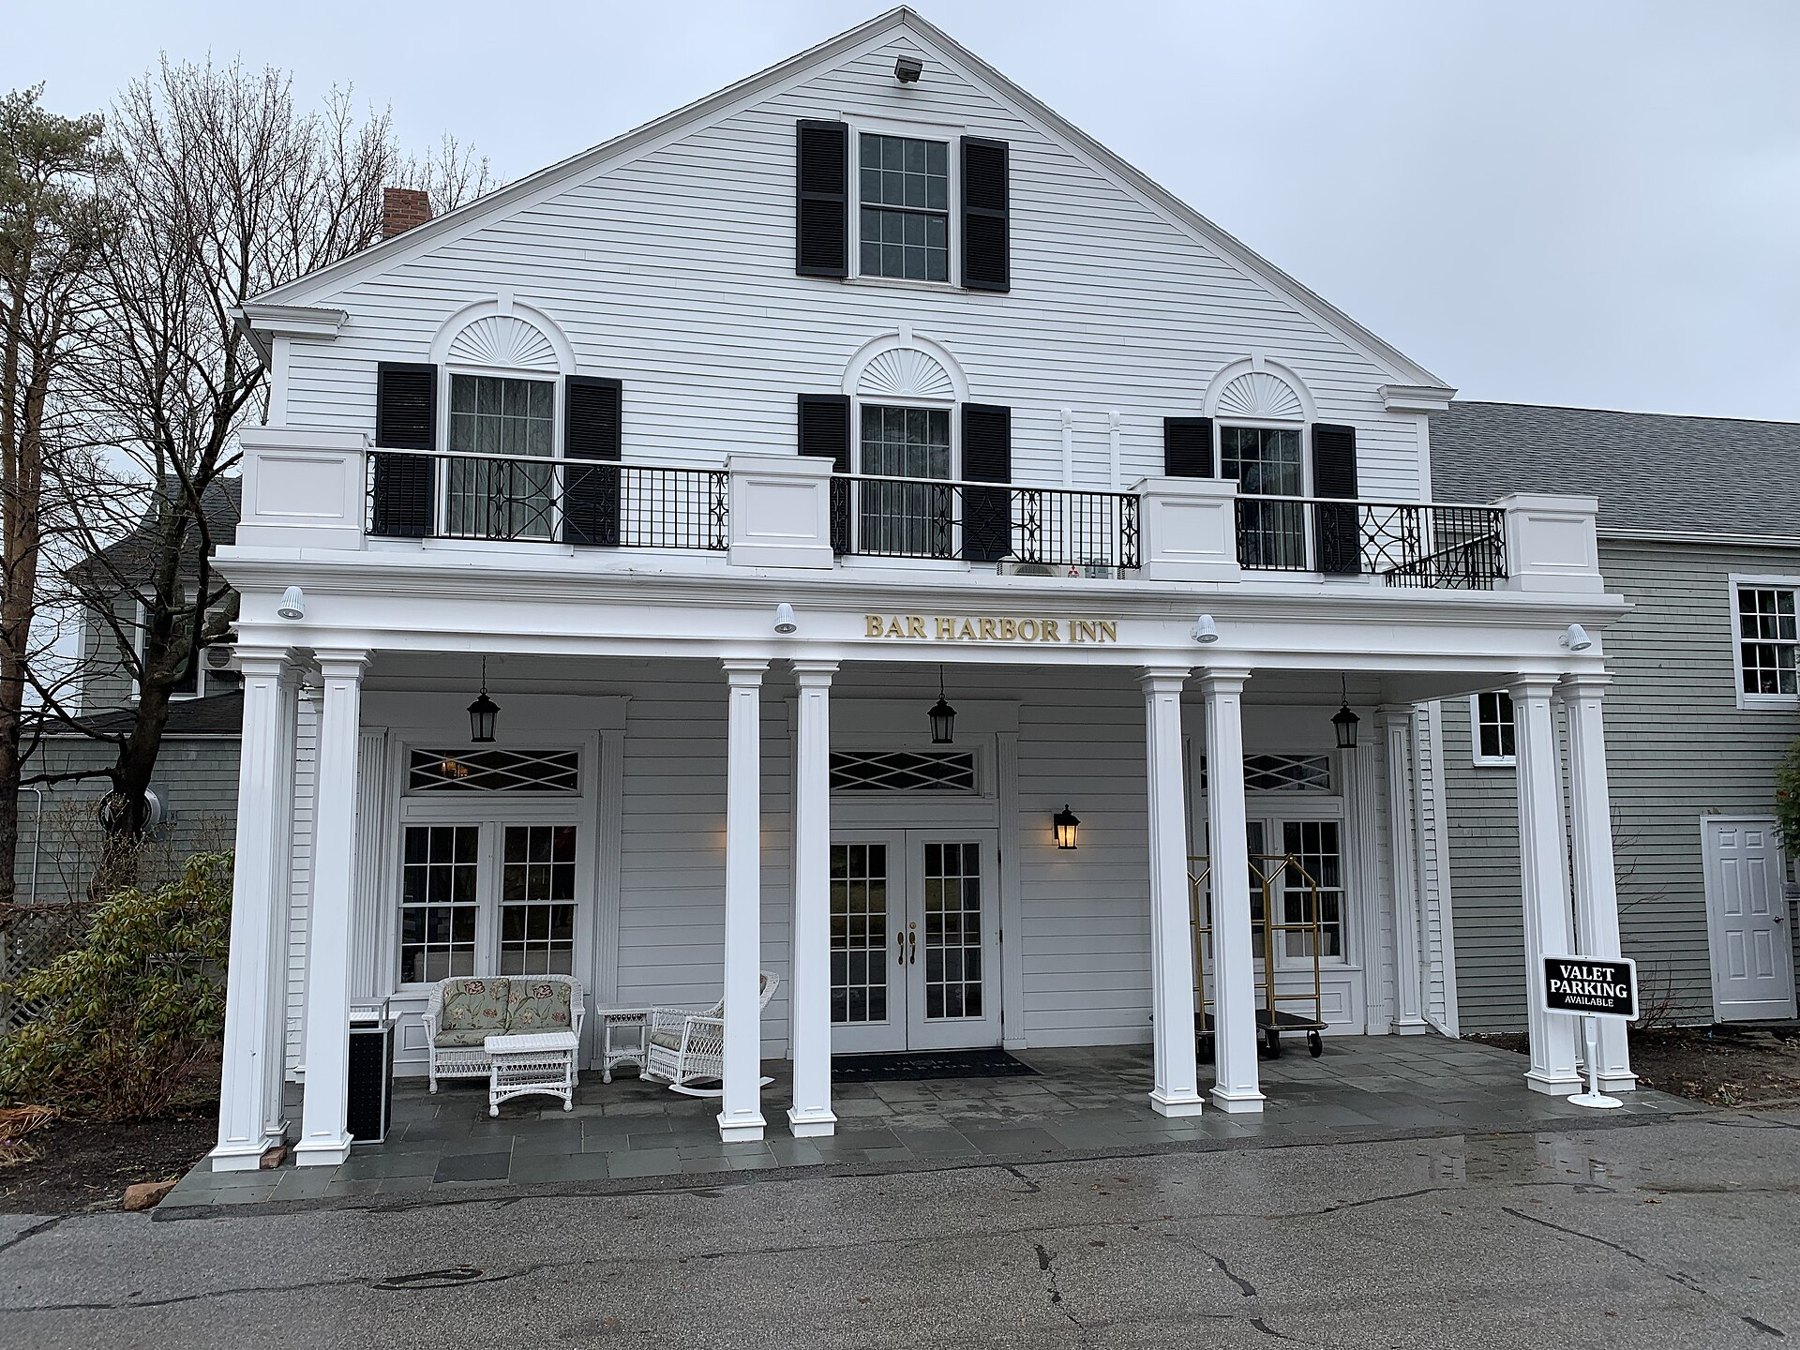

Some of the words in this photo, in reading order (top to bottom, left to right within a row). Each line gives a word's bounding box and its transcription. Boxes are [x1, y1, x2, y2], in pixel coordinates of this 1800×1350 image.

[865, 614, 927, 639] BAR
[934, 616, 1061, 642] HARBOR
[1069, 619, 1118, 643] INN
[1559, 965, 1615, 982] VALET
[1550, 979, 1628, 998] PARKING
[1564, 995, 1614, 1007] AVAILABLE
